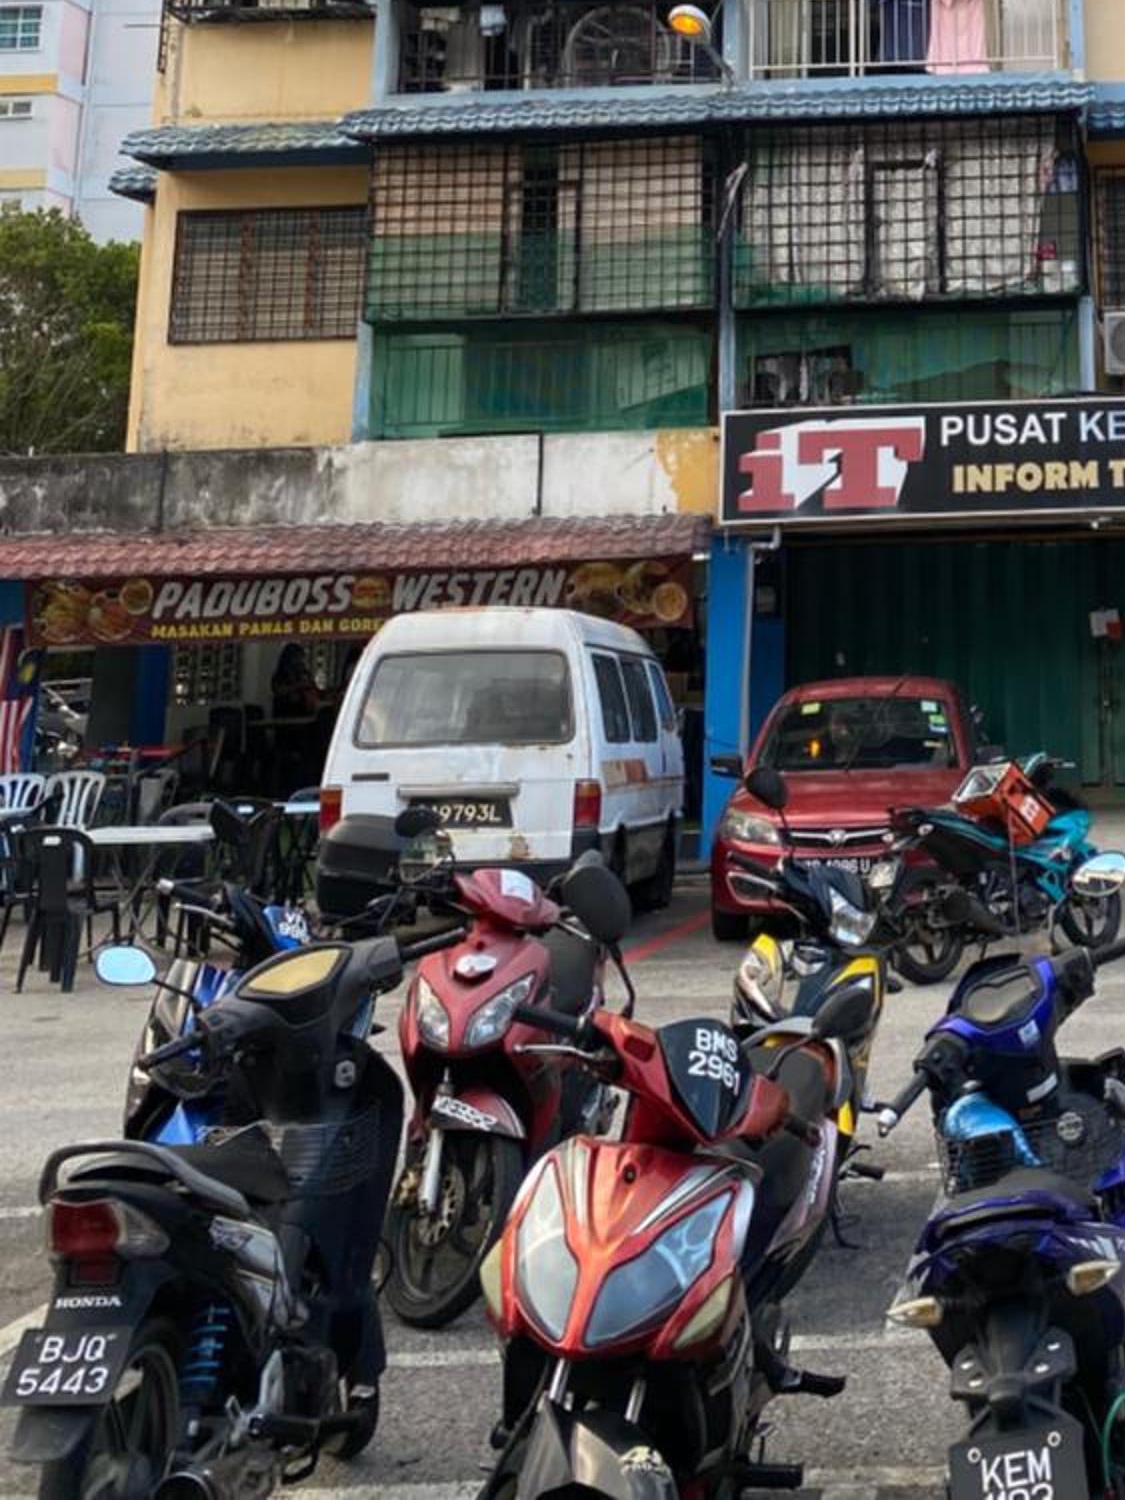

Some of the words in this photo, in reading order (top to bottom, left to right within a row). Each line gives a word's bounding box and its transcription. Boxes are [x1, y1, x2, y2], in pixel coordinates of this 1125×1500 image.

[940, 412, 1067, 446] PUSAT
[952, 460, 1100, 494] INFORM
[152, 574, 356, 620] PADUBOSS
[393, 568, 567, 611] WESTERN
[152, 623, 233, 639] MASAKAN
[239, 620, 293, 636] PANAS
[300, 618, 334, 634] DAN
[688, 1050, 740, 1097] 2961
[55, 1296, 122, 1309] HONDA
[38, 1334, 107, 1363] BJQ
[16, 1366, 109, 1396] 5443
[982, 1446, 1052, 1493] KEM
